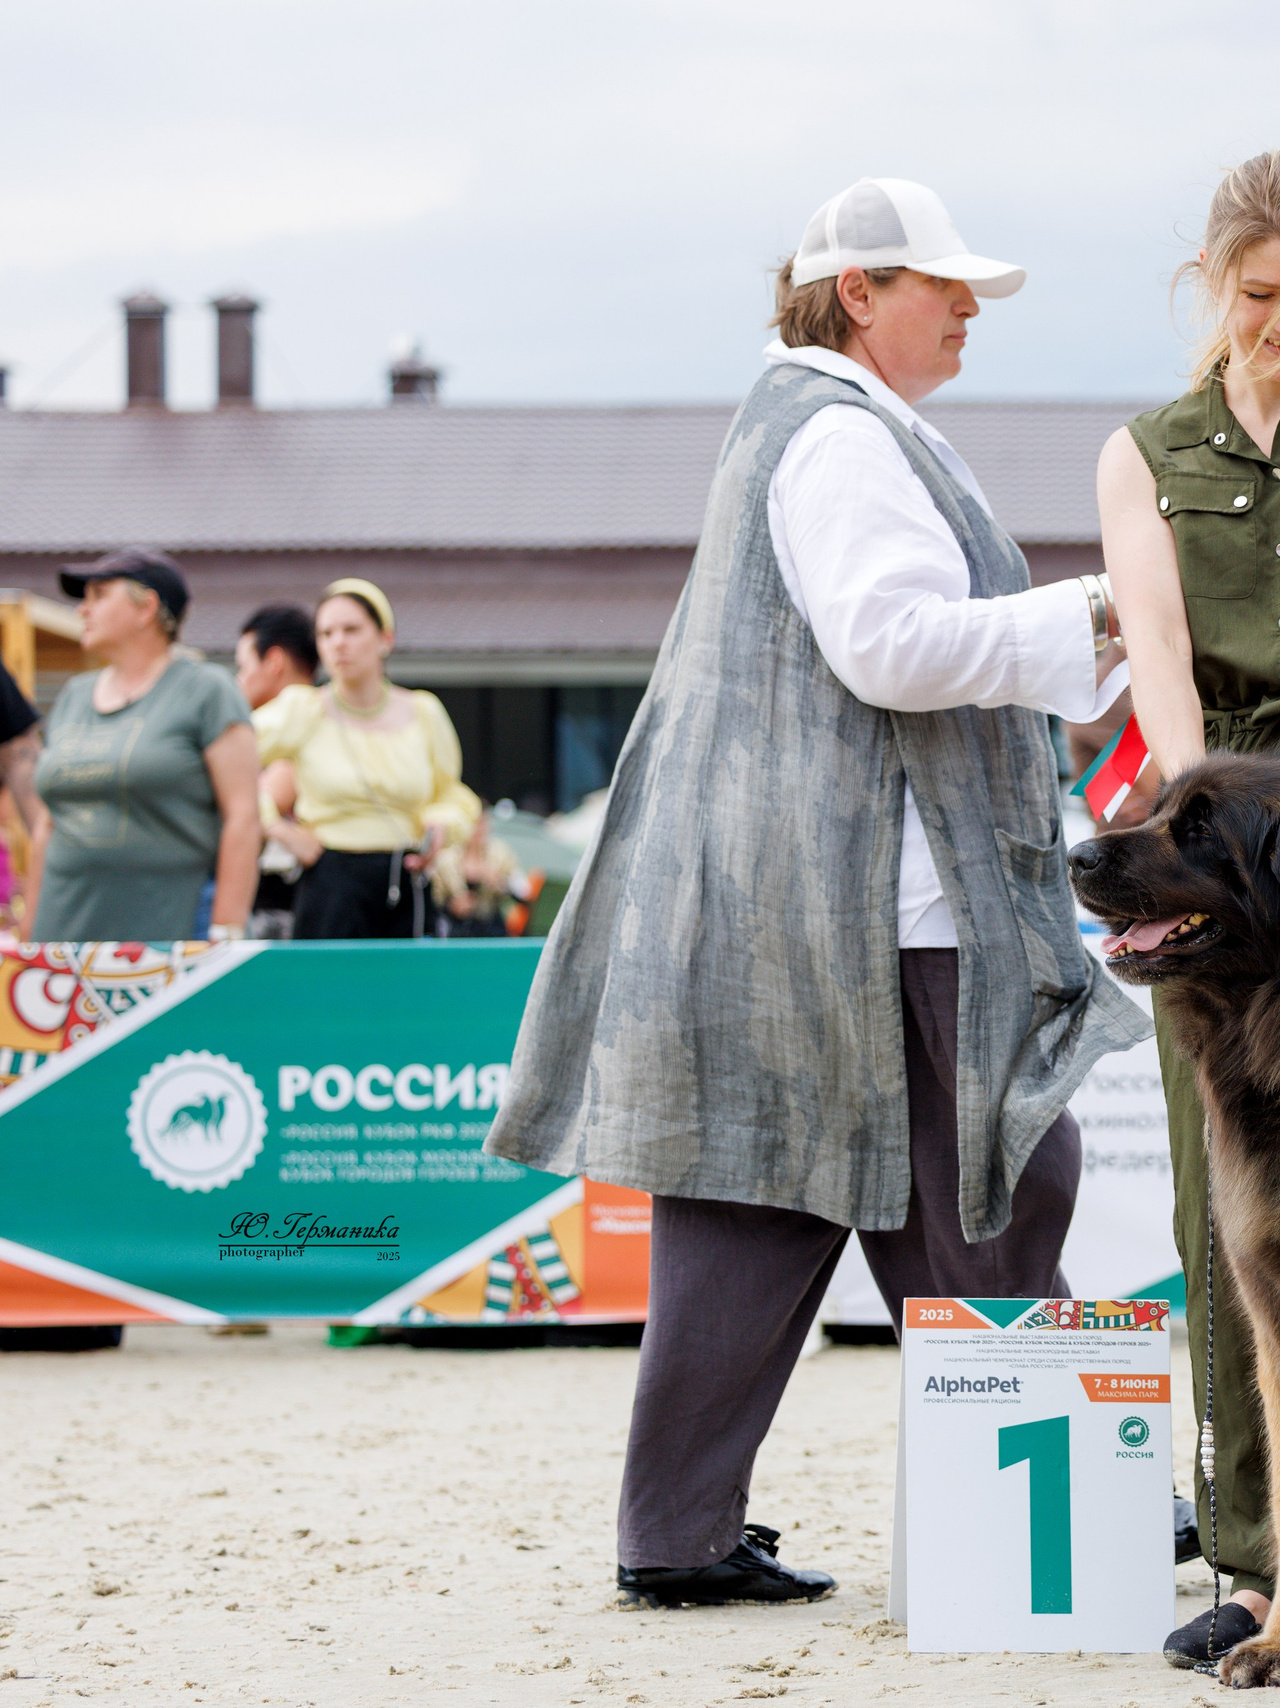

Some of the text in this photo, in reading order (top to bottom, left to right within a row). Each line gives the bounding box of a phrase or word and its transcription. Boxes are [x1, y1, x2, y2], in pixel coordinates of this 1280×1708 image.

[278, 1063, 510, 1112] РОССИЯ
[919, 1308, 954, 1321] 2025
[923, 1375, 1021, 1397] AlphaPet
[1094, 1378, 1102, 1389] 7
[1110, 1378, 1118, 1389] 8
[1120, 1379, 1159, 1389] ИЮНЯ
[1097, 1390, 1159, 1399] МАКСИМА ПАРК
[1115, 1451, 1154, 1459] РОССИЯ
[998, 1415, 1072, 1614] 1
